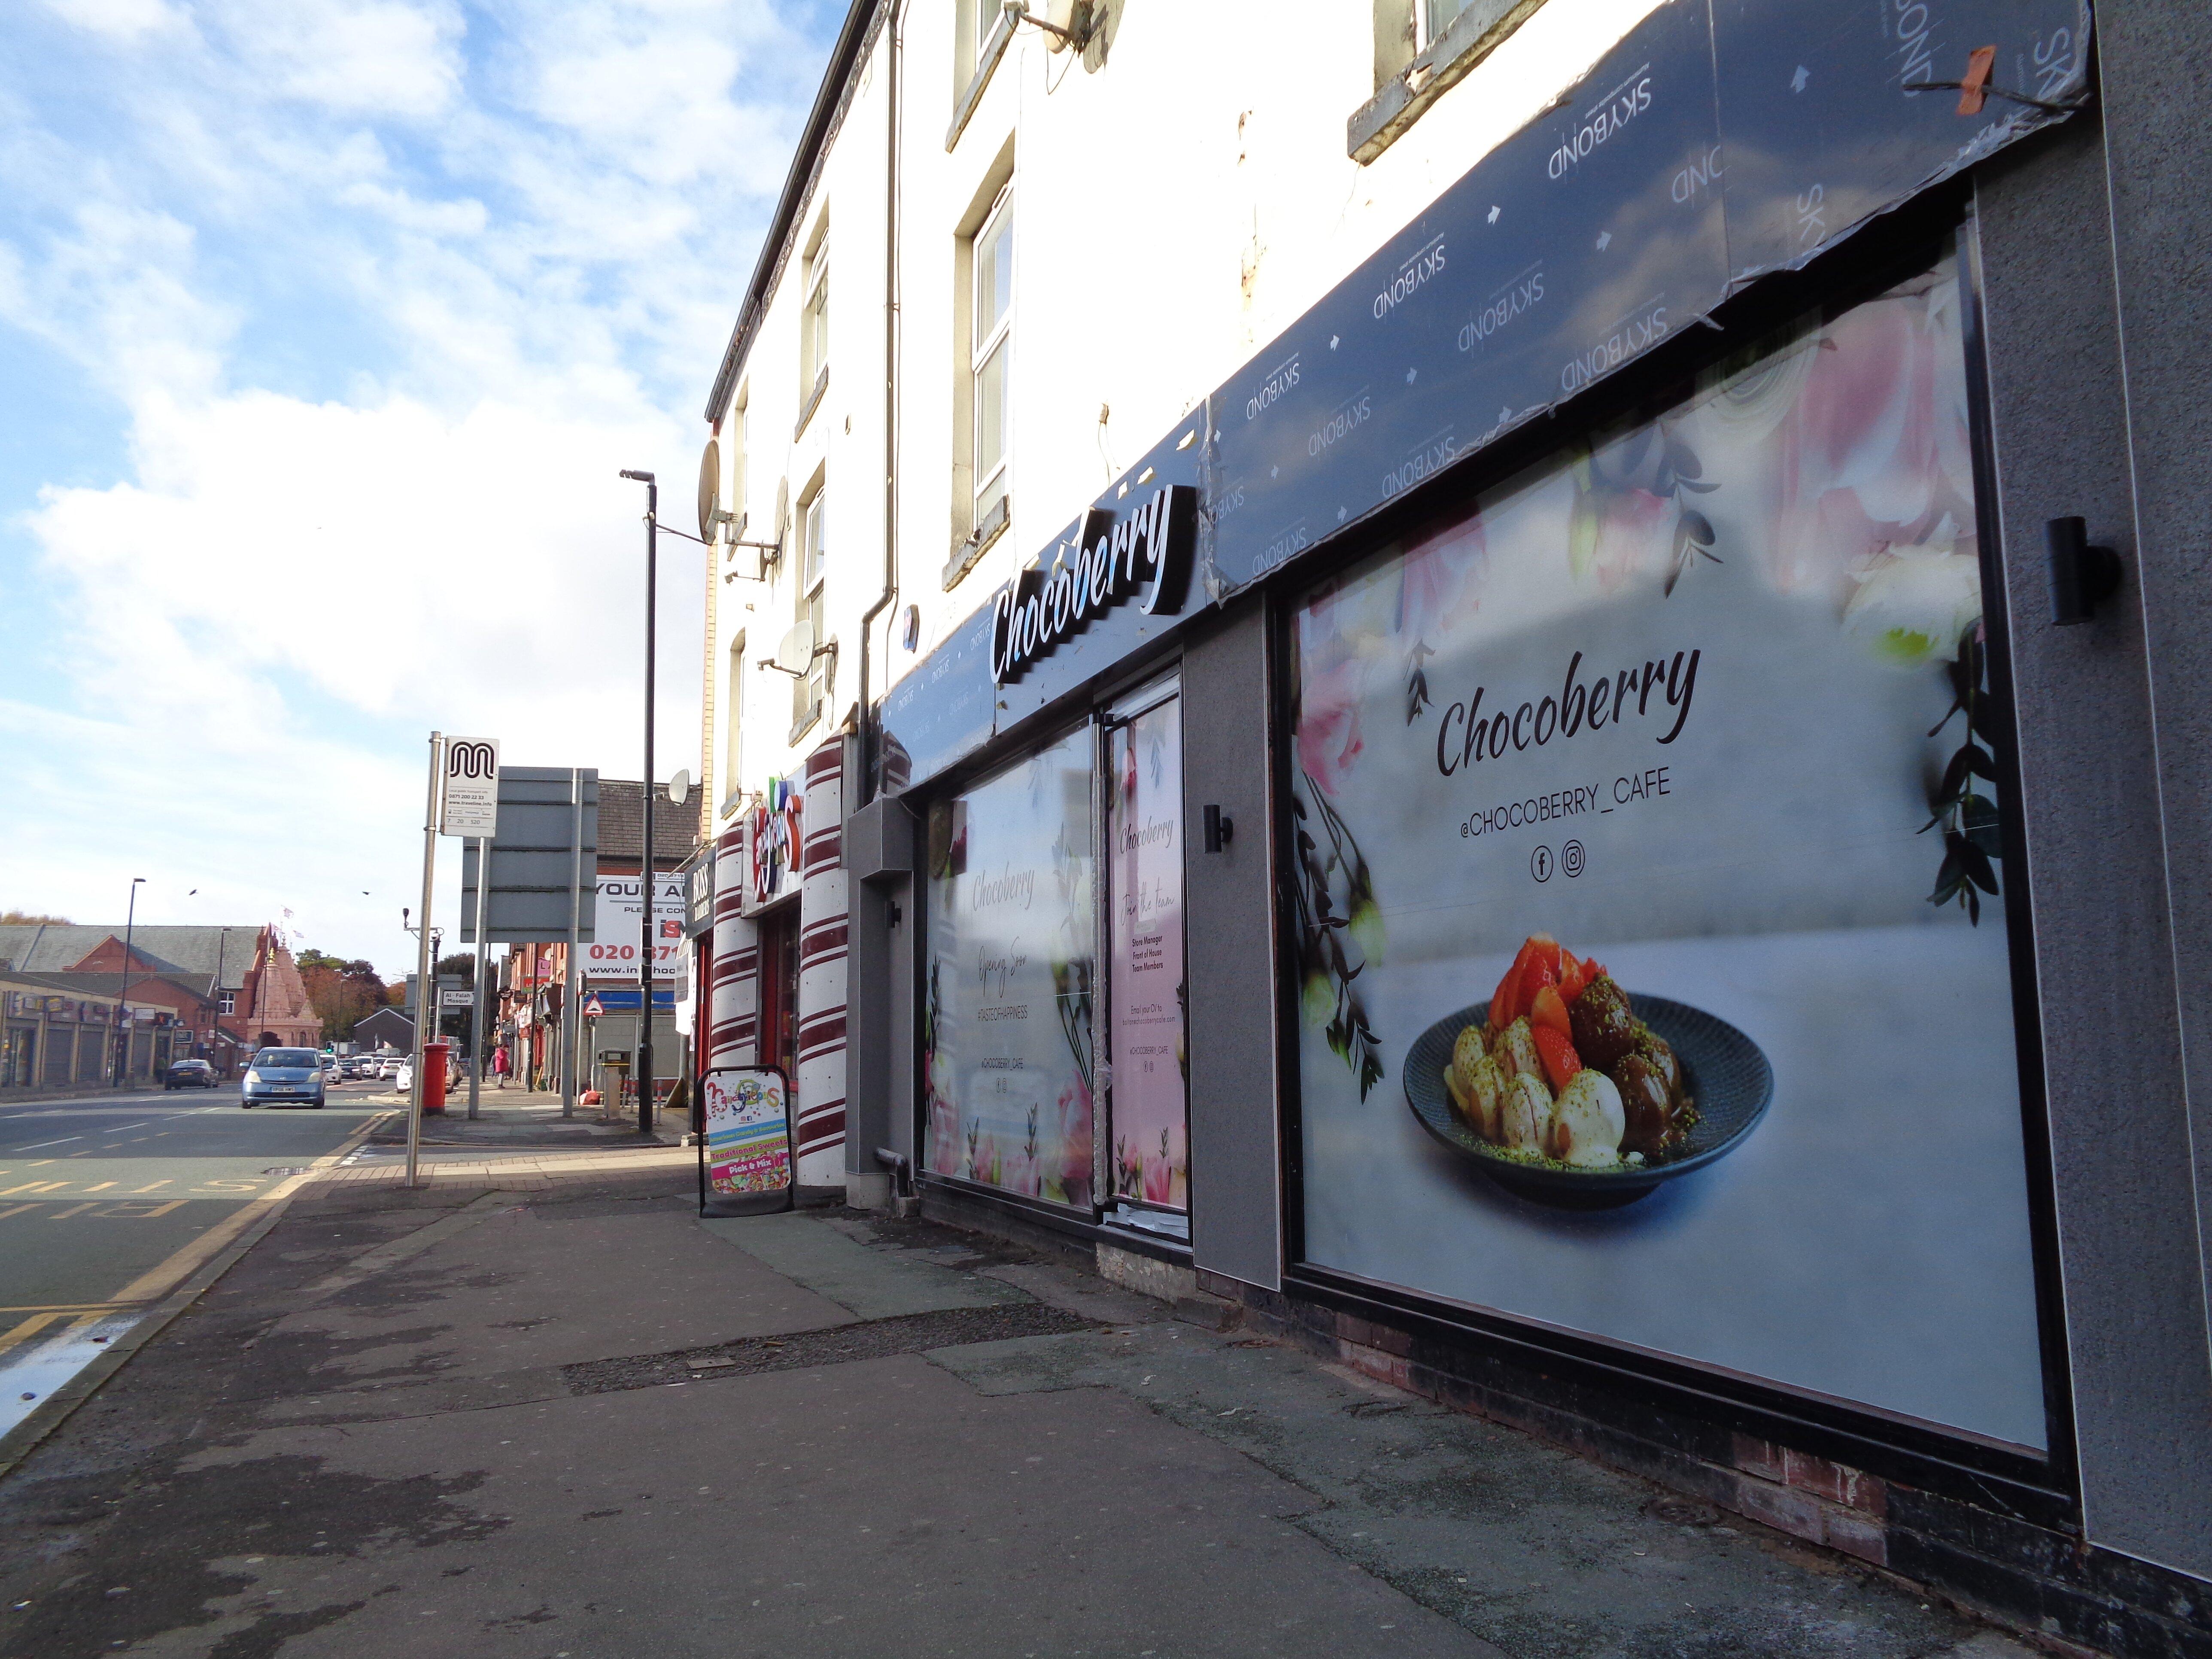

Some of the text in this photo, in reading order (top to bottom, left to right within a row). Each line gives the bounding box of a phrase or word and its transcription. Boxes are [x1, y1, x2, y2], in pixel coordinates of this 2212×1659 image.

[1549, 77, 1652, 179] SKYBOND
[1374, 245, 1445, 319] SKYBOND
[1459, 273, 1544, 352] SKYBOND
[1562, 307, 1668, 391] SKYBOND
[1247, 362, 1299, 420] SKYBOND
[1309, 396, 1370, 456] SKYBOND
[1382, 436, 1455, 498] SKYBOND
[1253, 527, 1307, 575] SKYBOND
[989, 484, 1174, 684] Chocoberry
[970, 623, 991, 651] SKYBOND
[931, 659, 950, 684] SKYBOND
[898, 689, 914, 711] SKYBOND
[1437, 649, 1701, 777] Chocoberry
[1461, 766, 1671, 838] @CHOCOBERRY_CAFE
[1120, 815, 1173, 854] Chocoberry
[664, 885, 685, 897] A
[693, 863, 708, 904] BOSS
[973, 861, 1035, 911] Chocoberry
[1121, 877, 1175, 926] Join the team
[589, 945, 634, 960] 020
[1132, 936, 1163, 947] Store Manager
[1133, 948, 1162, 960] Front of House
[978, 936, 1027, 998] Opening Soon
[1132, 960, 1163, 973] Team Members
[978, 1005, 1028, 1021] #TASTEOFHAPPINESS
[1131, 1003, 1141, 1015] Email
[1142, 1006, 1150, 1016] your
[1151, 1003, 1157, 1013] CV
[981, 1057, 1024, 1071] @CHOCOBERRY_CAFE
[1130, 1046, 1168, 1056] @CHOCOBERRY_CAFE
[711, 1139, 787, 1160] Traditional Sweets
[729, 1164, 748, 1174] Pick
[756, 1159, 772, 1168] Mix
